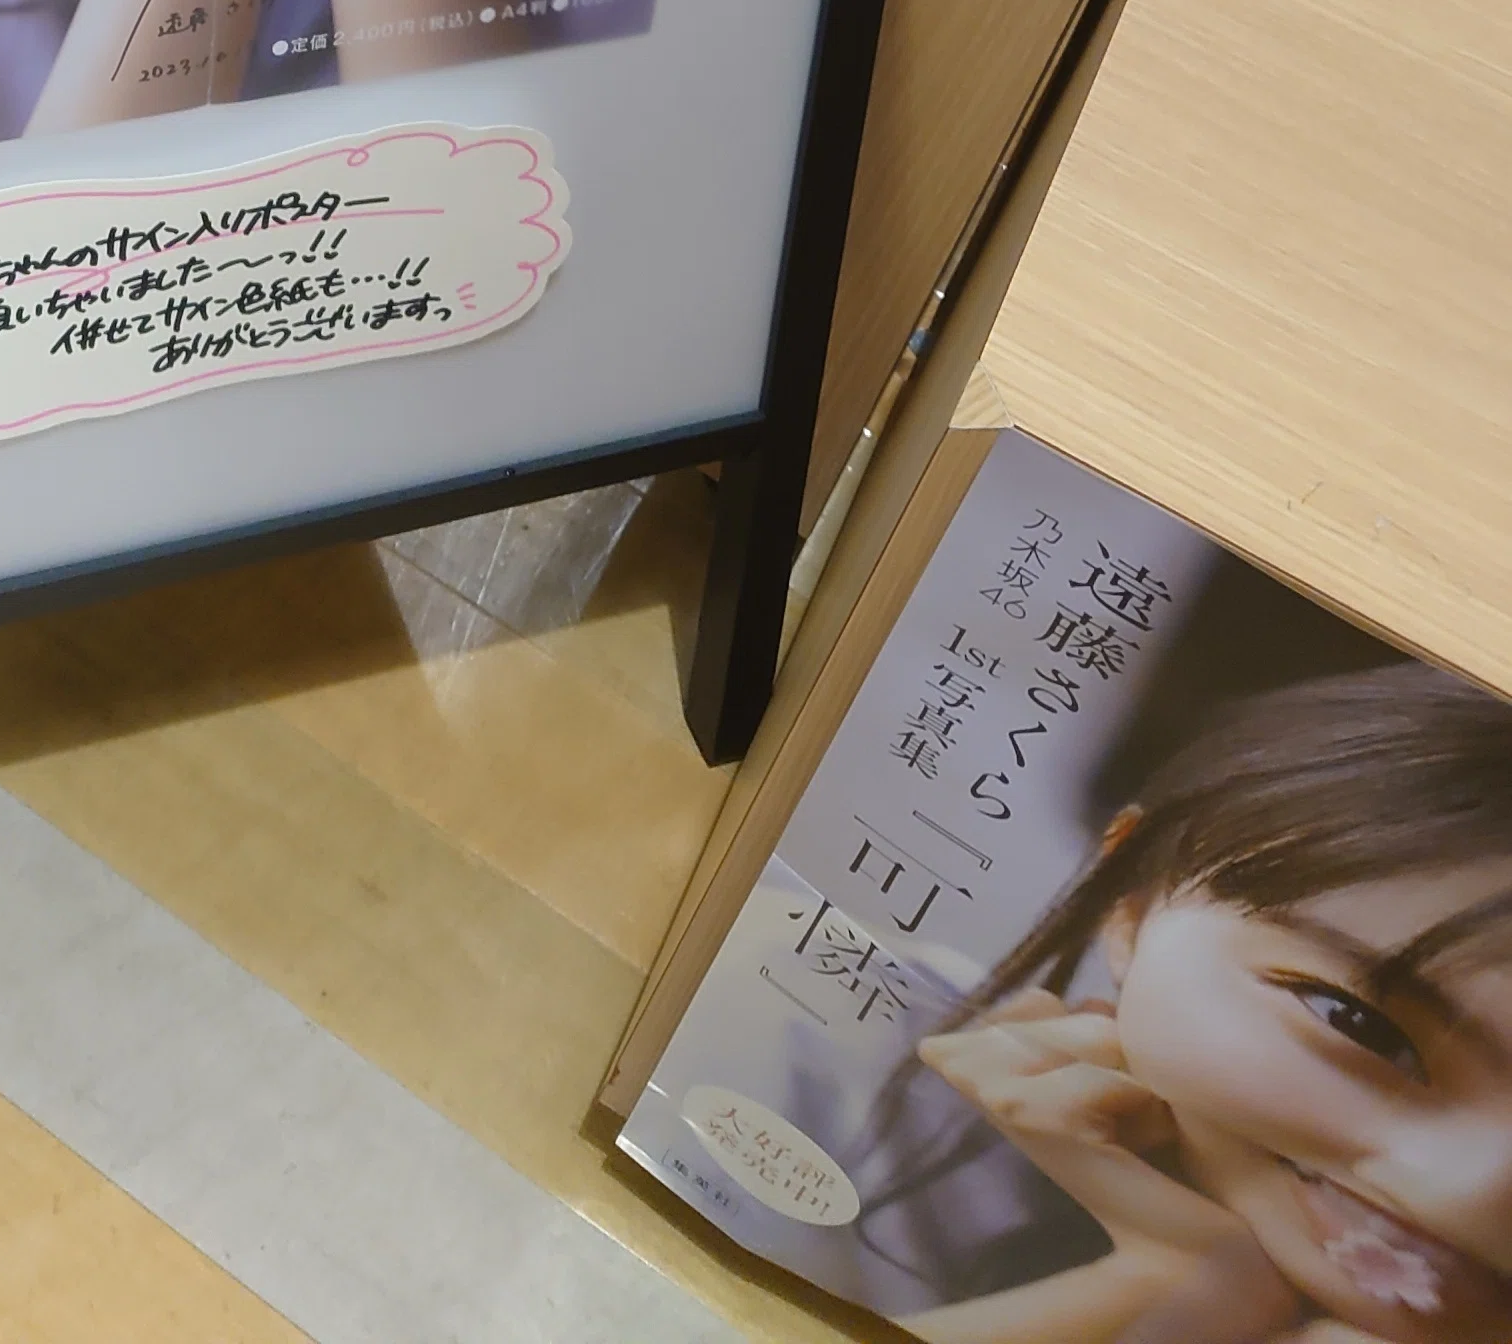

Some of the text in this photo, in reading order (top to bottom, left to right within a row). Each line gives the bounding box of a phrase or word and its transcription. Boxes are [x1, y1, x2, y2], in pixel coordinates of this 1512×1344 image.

[148, 291, 453, 373] ありがとうございますっ
[978, 508, 1065, 621] 乃木坂46
[969, 539, 1173, 821] 遠藤さくら
